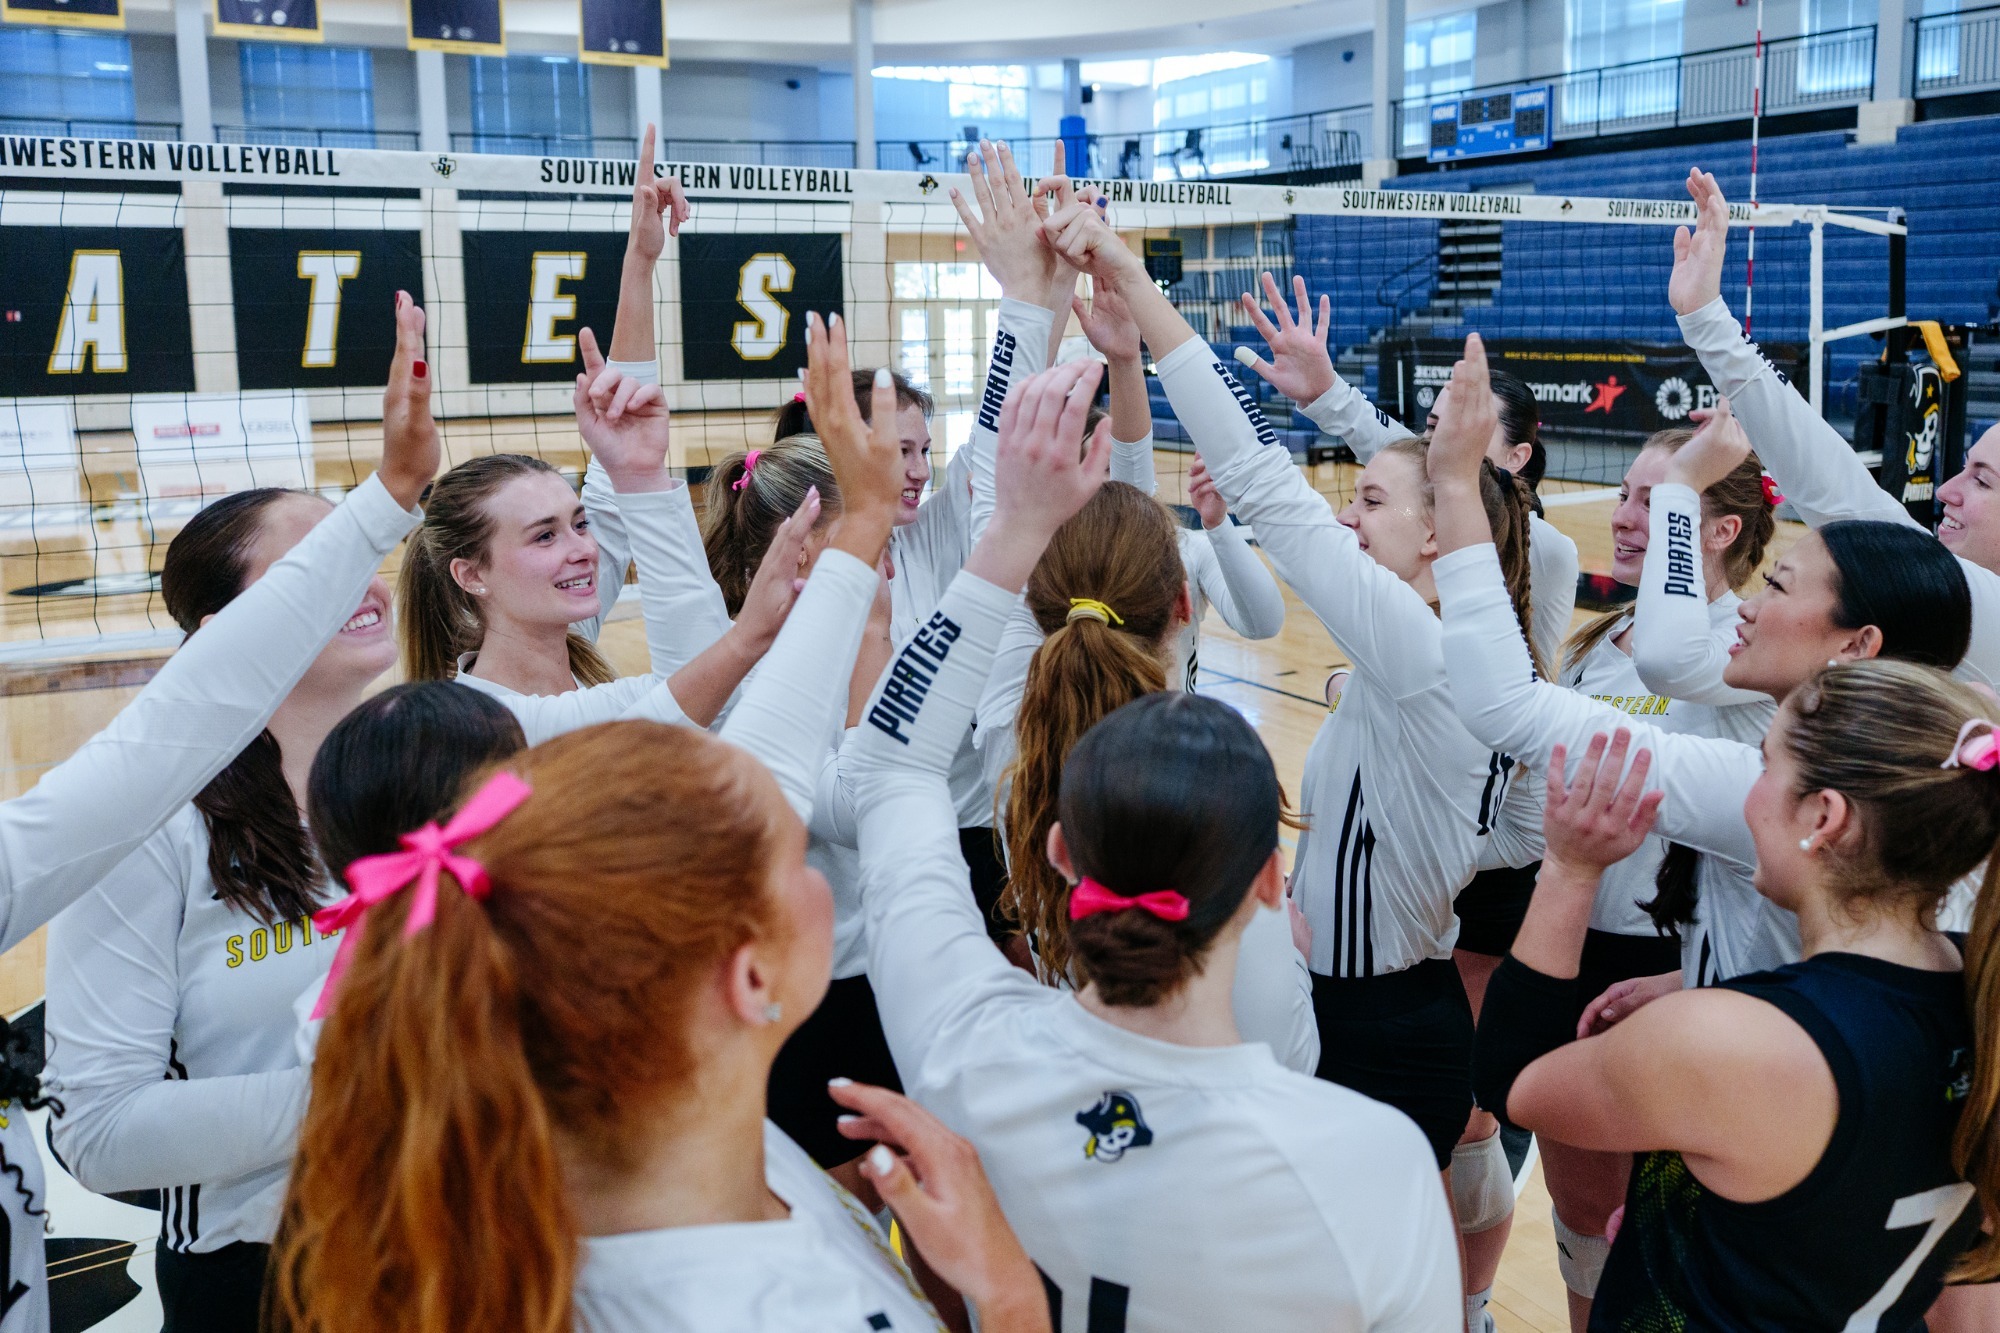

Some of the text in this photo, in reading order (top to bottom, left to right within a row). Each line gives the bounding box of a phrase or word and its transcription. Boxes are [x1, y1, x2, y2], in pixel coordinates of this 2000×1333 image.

[167, 143, 340, 176] VOLLEYBALL
[541, 158, 853, 193] SOUTHWSTERN VOLLEYBALL
[1140, 181, 1232, 205] VOLLEYBALL
[1343, 190, 1522, 214] SOUTHWESTERN VOLLEYBALL
[1608, 200, 1689, 219] SOUTHWESTERN
[47, 249, 128, 374] A
[297, 250, 362, 368] T
[521, 252, 588, 363] E
[730, 253, 796, 360] S
[978, 330, 1016, 434] PIRATES
[1664, 512, 1698, 598] PIRATES
[849, 610, 962, 747] PIRATES
[226, 914, 340, 969] SOUT
[1840, 1181, 1977, 1333] 7
